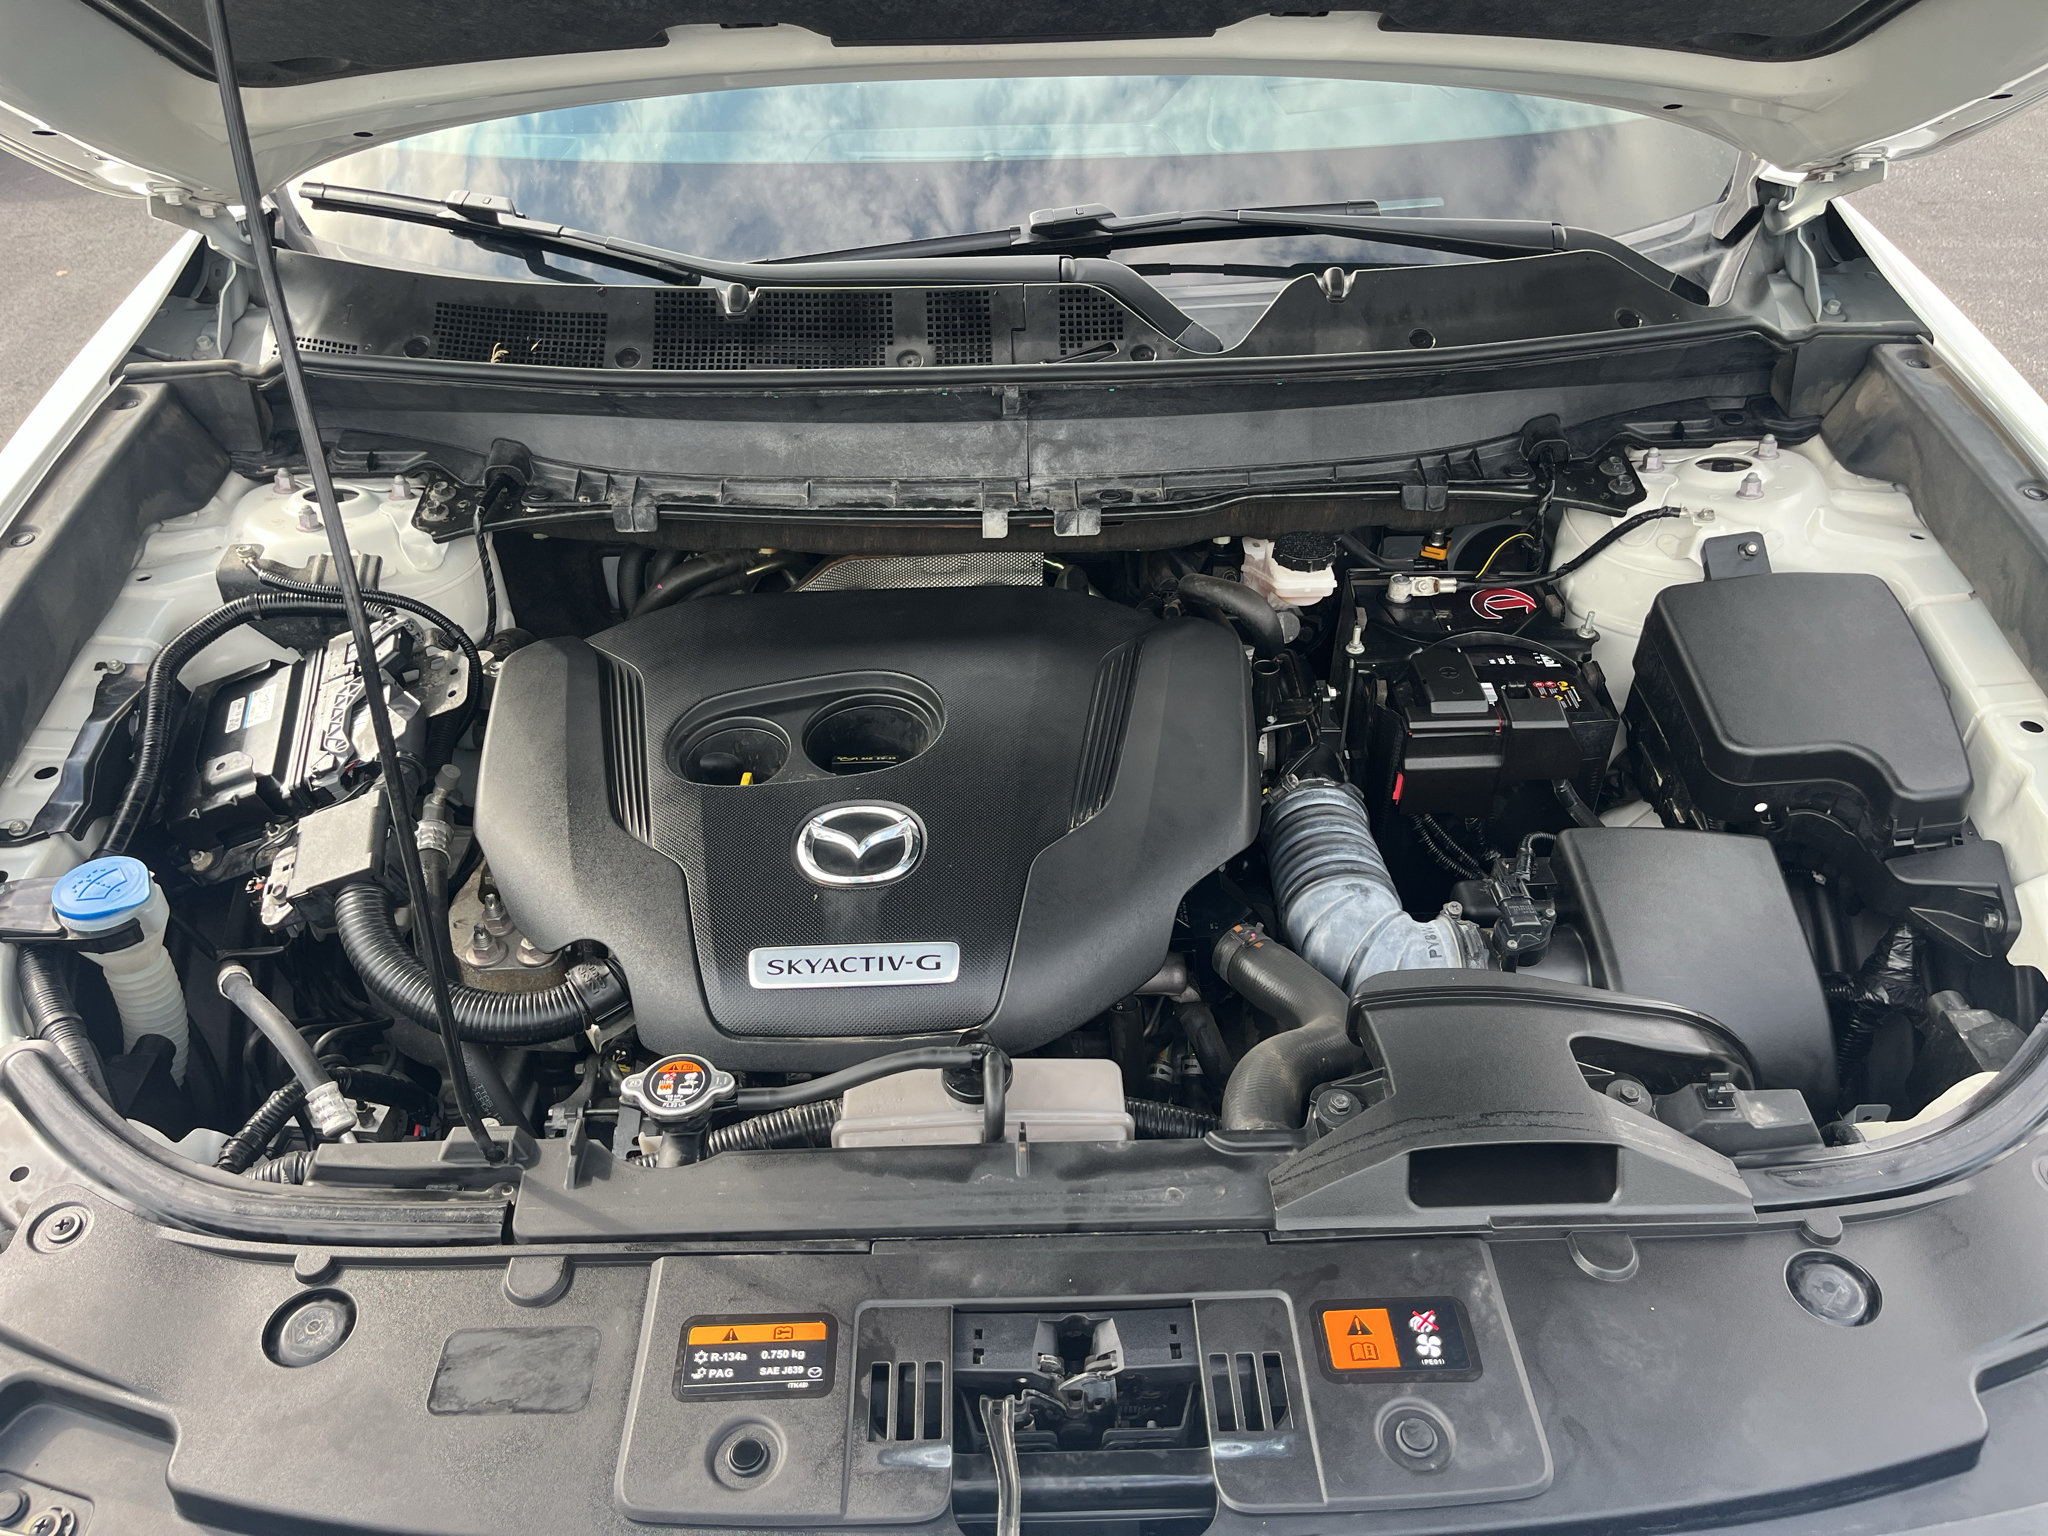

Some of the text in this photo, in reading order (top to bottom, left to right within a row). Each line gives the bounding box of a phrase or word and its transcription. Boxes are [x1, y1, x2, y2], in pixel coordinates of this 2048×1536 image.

[766, 954, 941, 976] SKYACTIV-G
[710, 1349, 806, 1361] R-134a 0.750 kg
[708, 1365, 804, 1378] PAG SAE J639
